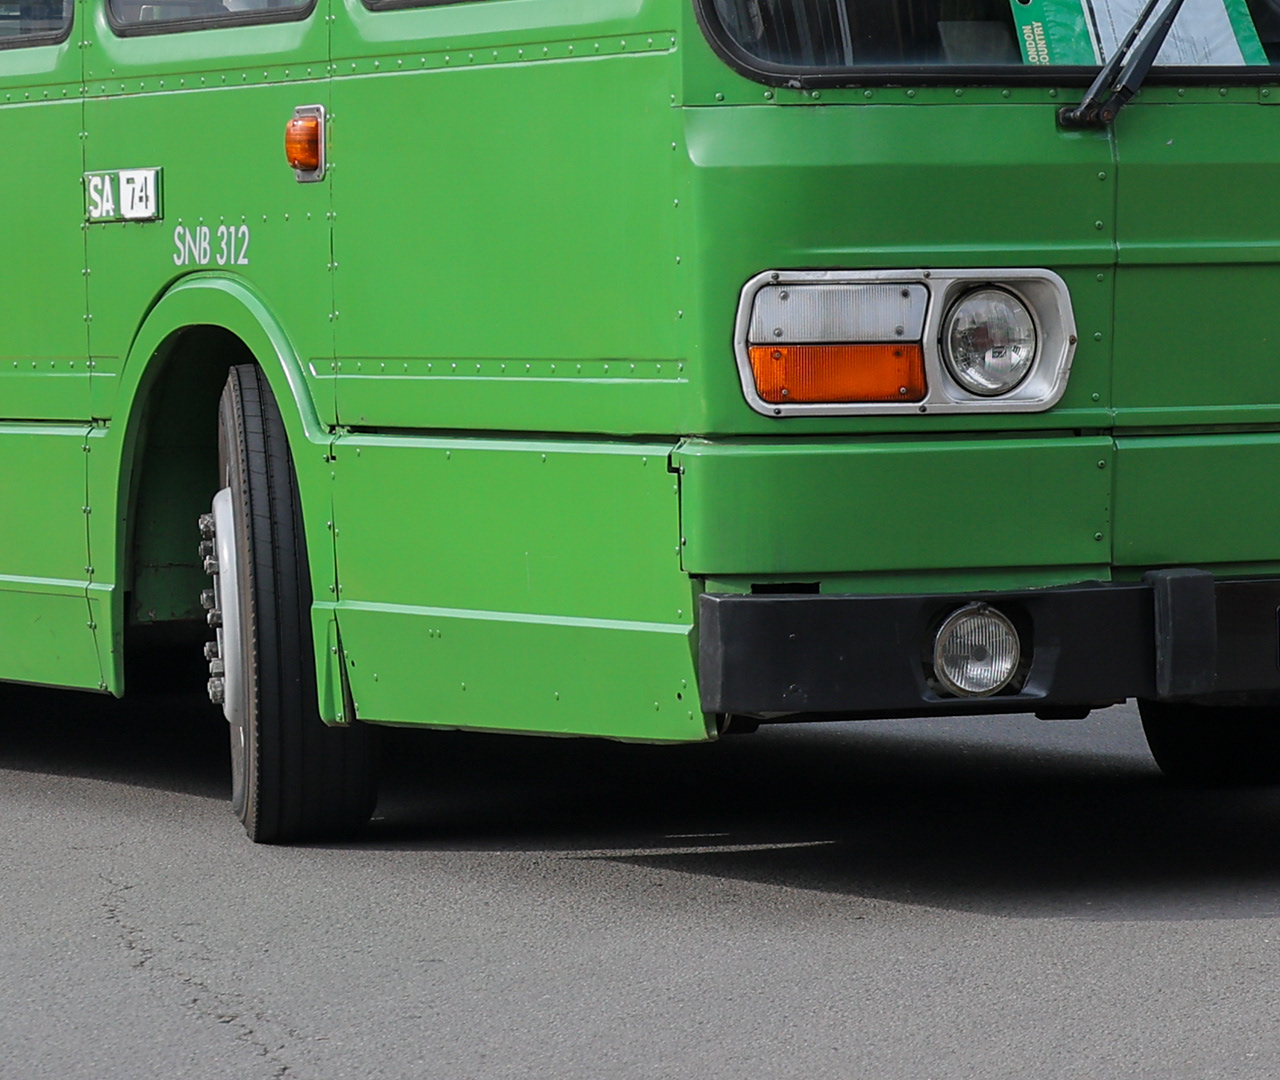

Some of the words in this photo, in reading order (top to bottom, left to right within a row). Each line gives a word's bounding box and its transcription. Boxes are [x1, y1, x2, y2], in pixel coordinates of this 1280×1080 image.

[1022, 25, 1039, 65] ONDON
[89, 175, 114, 217] SA
[173, 225, 210, 265] SNB
[216, 225, 249, 265] 312
